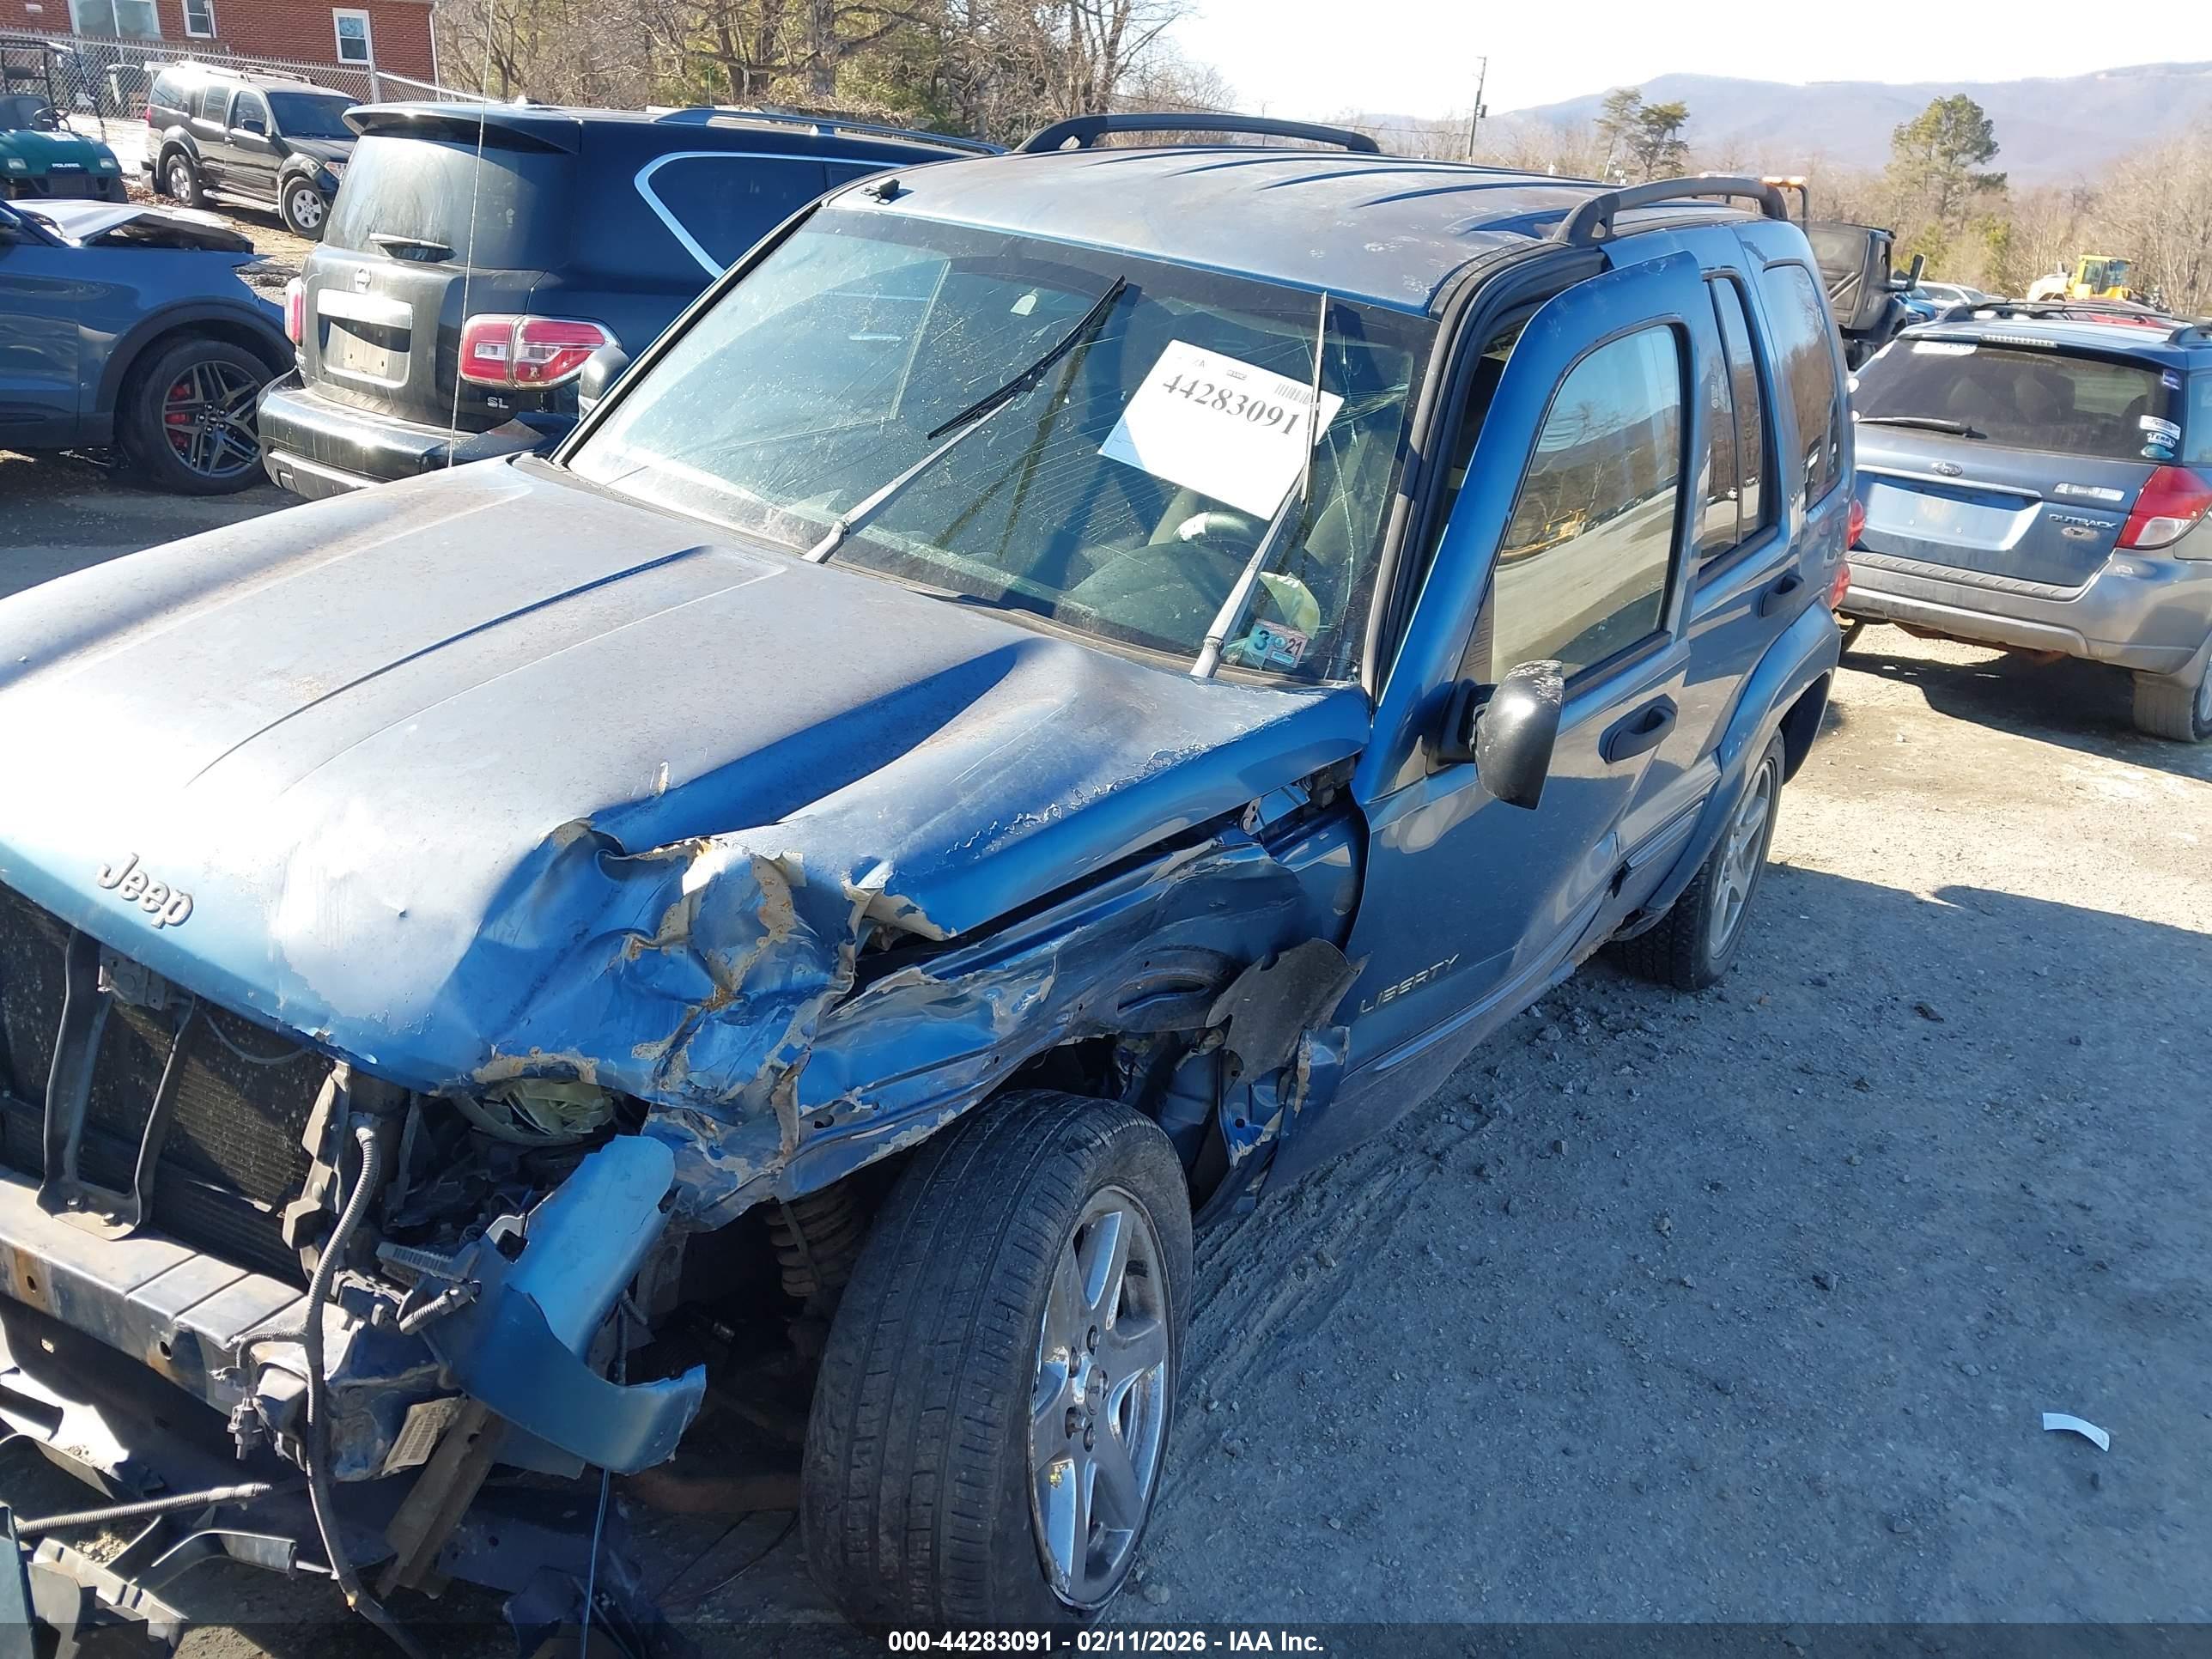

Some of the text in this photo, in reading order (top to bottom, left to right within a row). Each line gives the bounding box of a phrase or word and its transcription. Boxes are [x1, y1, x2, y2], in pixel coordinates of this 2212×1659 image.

[487, 396, 509, 409] SL
[1162, 374, 1299, 435] 44283091
[2048, 514, 2118, 529] OUTBACK
[1254, 629, 1270, 651] 3
[1284, 637, 1303, 656] 21
[96, 851, 194, 930] Jeep
[1359, 953, 1460, 1013] LIBERTY
